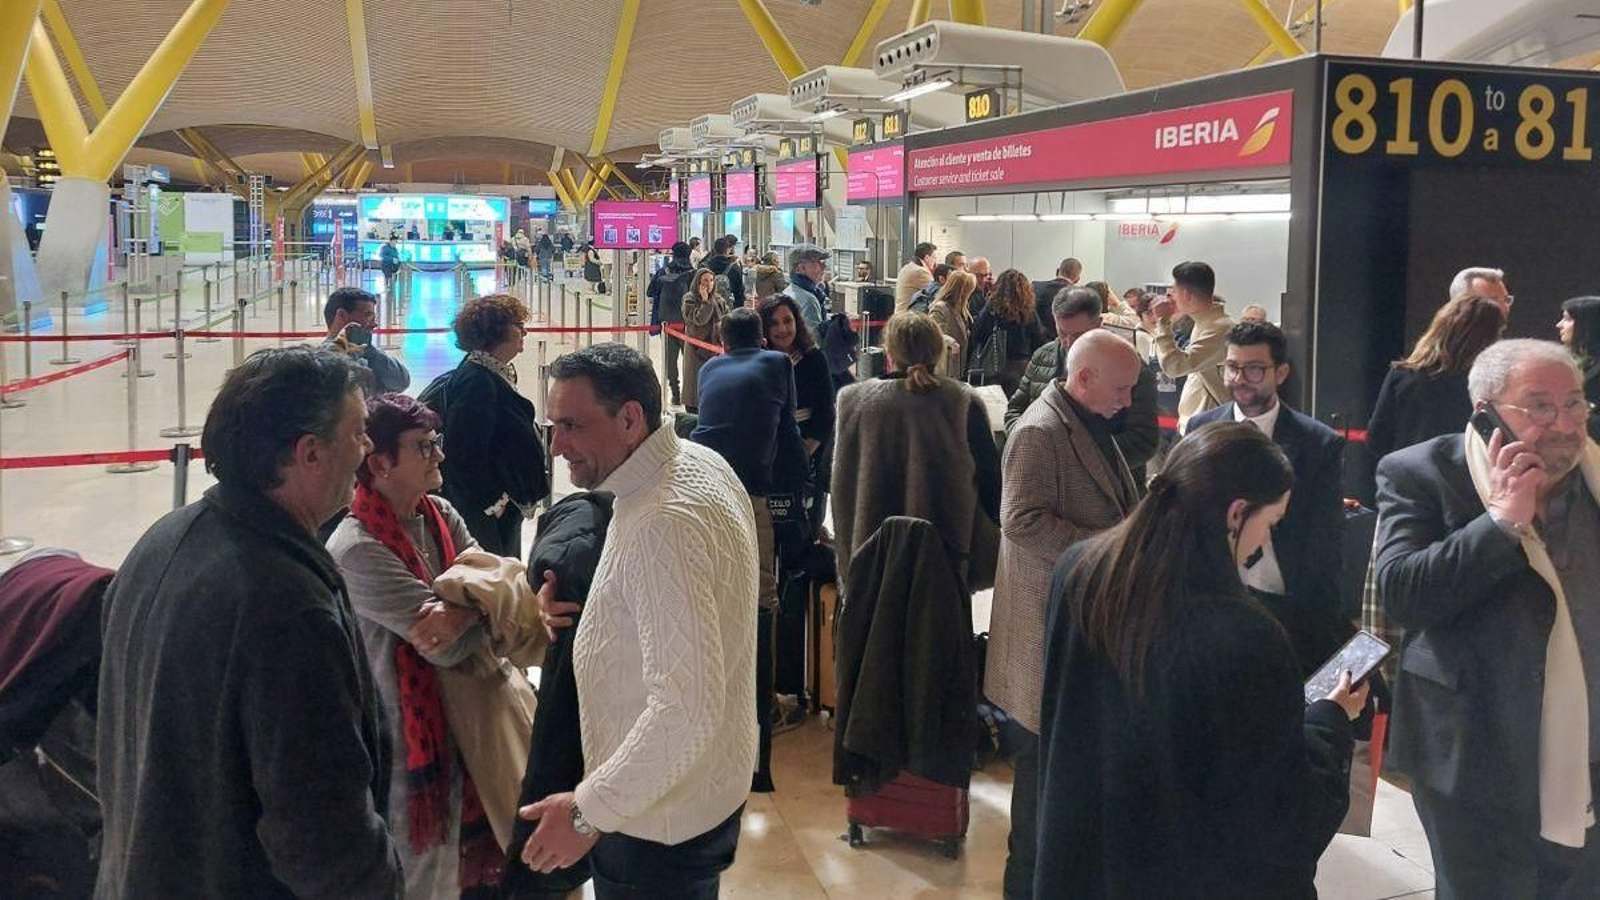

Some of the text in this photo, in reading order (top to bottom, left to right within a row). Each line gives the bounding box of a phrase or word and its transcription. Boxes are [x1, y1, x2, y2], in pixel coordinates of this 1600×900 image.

[968, 94, 990, 119] 810
[1485, 84, 1505, 111] to
[1332, 73, 1474, 158] 810
[1155, 117, 1239, 150] IBERIA
[1483, 127, 1499, 151] a
[914, 156, 938, 169] Atención
[945, 152, 967, 165] cliente
[972, 149, 992, 162] venta
[993, 148, 1002, 160] de
[1002, 144, 1032, 160] billetes
[914, 174, 938, 187] Customer
[938, 172, 959, 185] service
[959, 169, 971, 183] and
[971, 168, 989, 182] ticket
[990, 166, 1005, 180] sale
[1118, 223, 1160, 236] IBERIA
